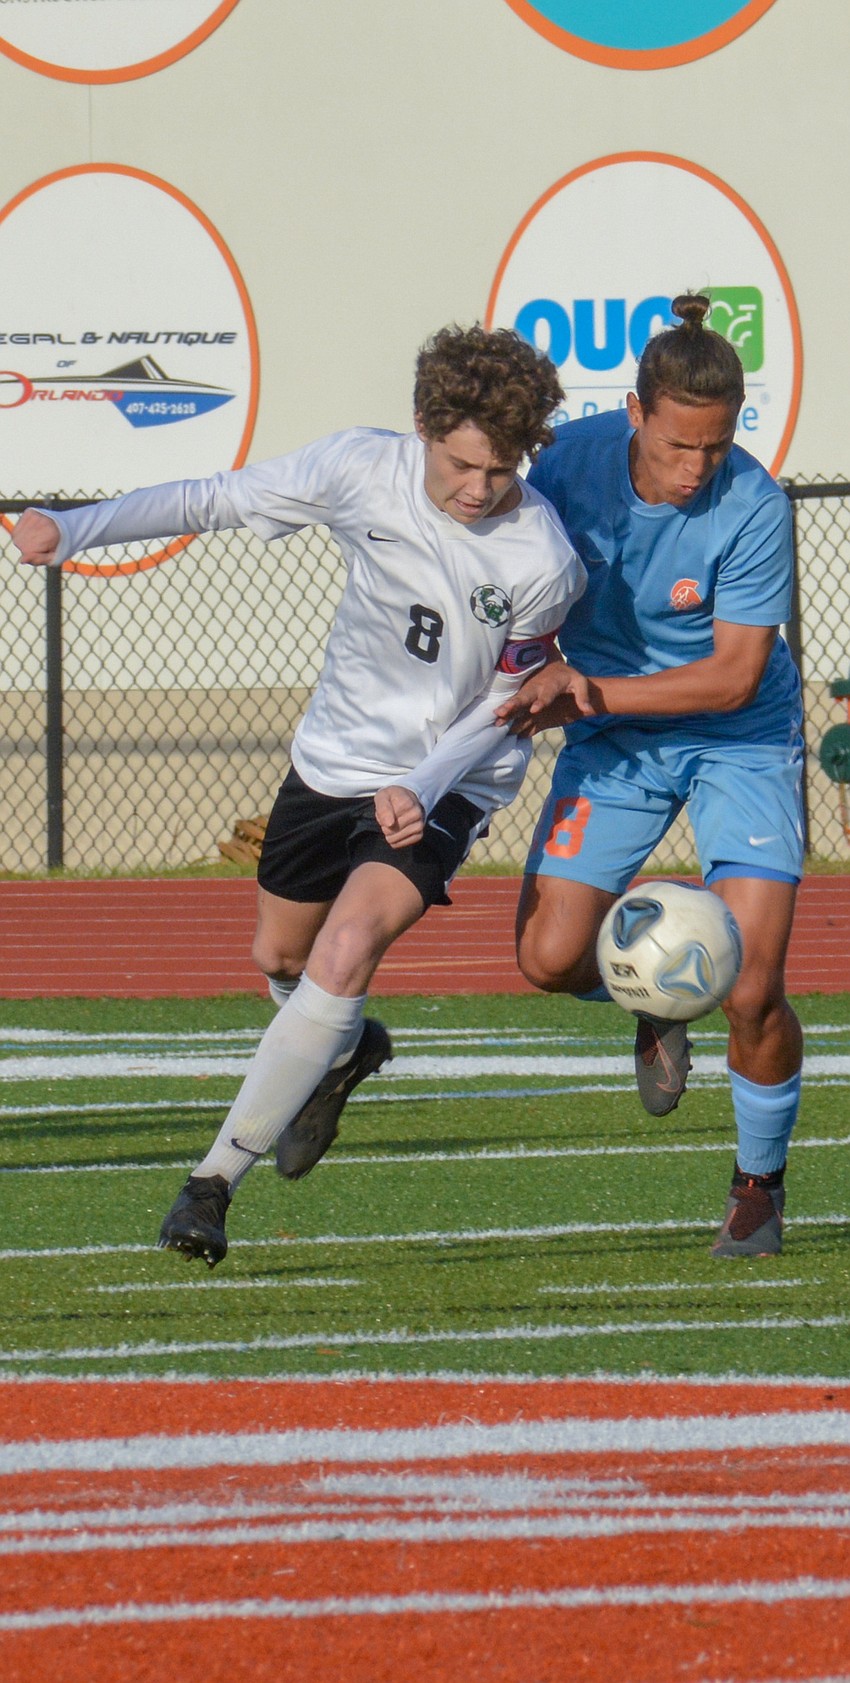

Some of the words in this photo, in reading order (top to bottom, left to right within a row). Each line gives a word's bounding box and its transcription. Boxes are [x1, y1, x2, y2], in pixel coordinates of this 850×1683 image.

[80, 332, 103, 345] &
[106, 331, 238, 346] NAUTIQUE
[56, 360, 77, 368] OF
[405, 603, 444, 664] 8
[515, 644, 543, 667] C
[544, 796, 592, 859] 8
